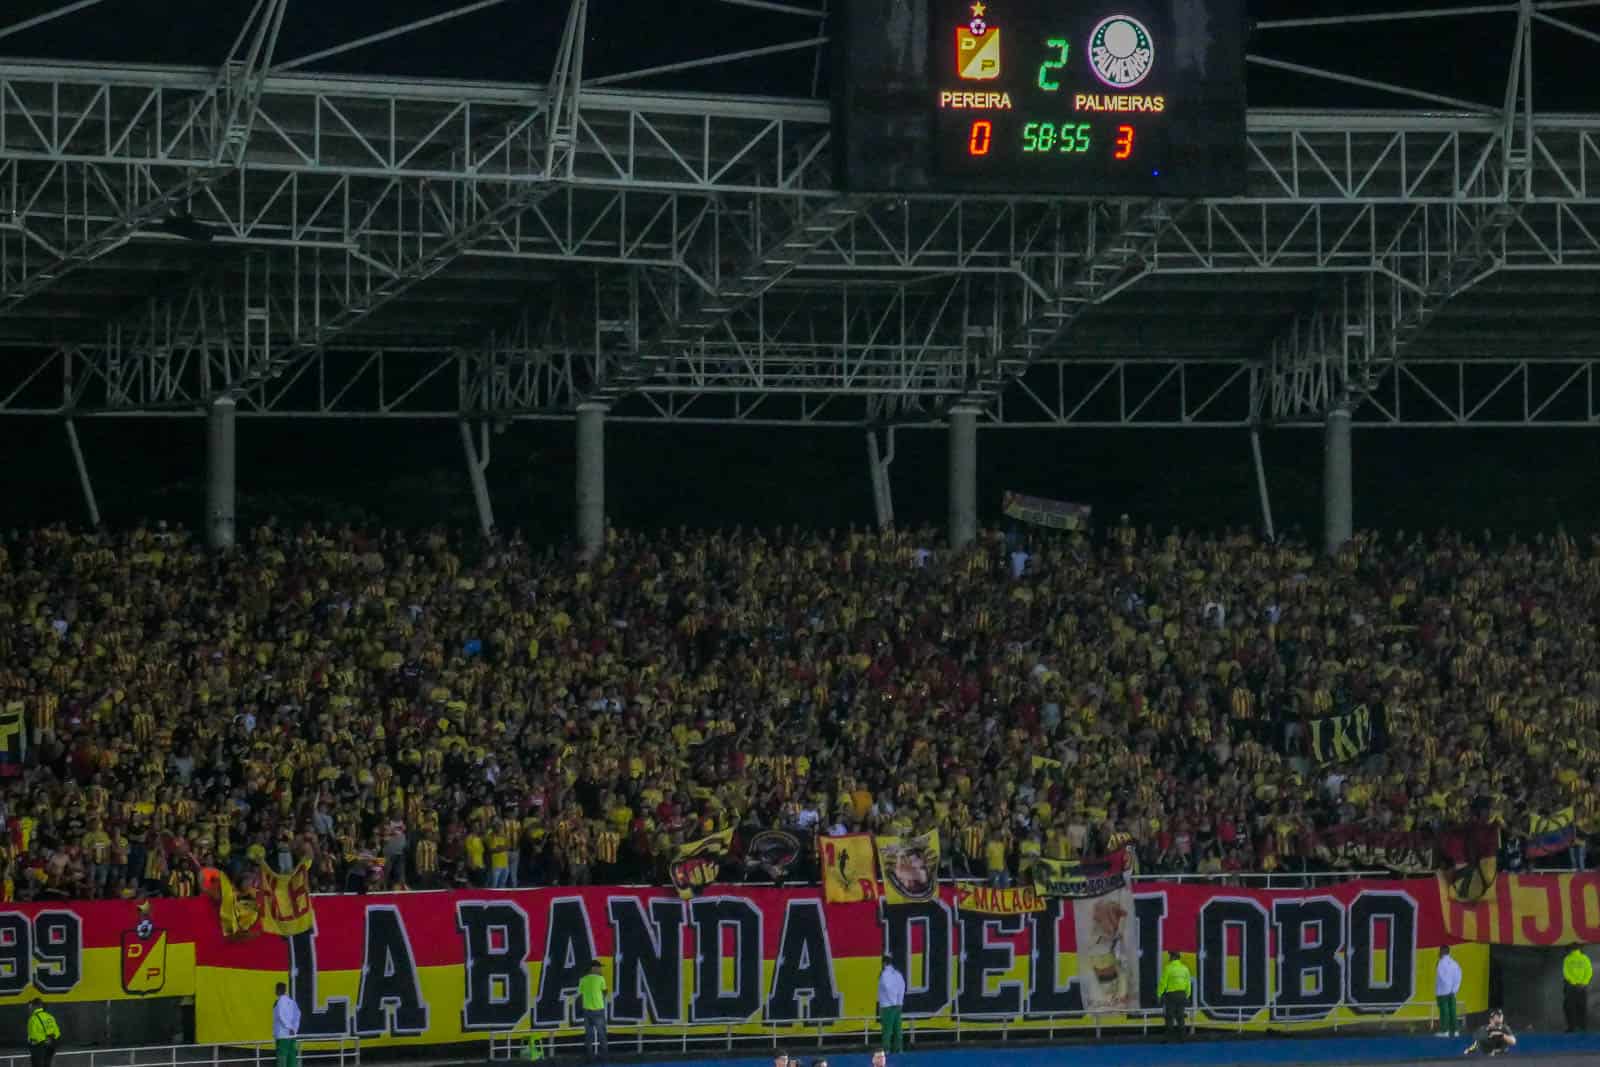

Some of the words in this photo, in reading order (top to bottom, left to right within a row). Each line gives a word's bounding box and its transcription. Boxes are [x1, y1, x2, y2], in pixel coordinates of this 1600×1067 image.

[1038, 38, 1069, 91] 2
[1092, 46, 1151, 83] PALMEIRAS
[941, 91, 1012, 109] PEREIRA
[1075, 94, 1165, 112] PALMEIRAS
[970, 121, 991, 155] 0
[1023, 123, 1091, 152] 58:55
[1115, 125, 1134, 159] 3
[288, 900, 430, 1039] LA
[455, 895, 843, 1029] BANDA
[878, 894, 1087, 1020] DEL
